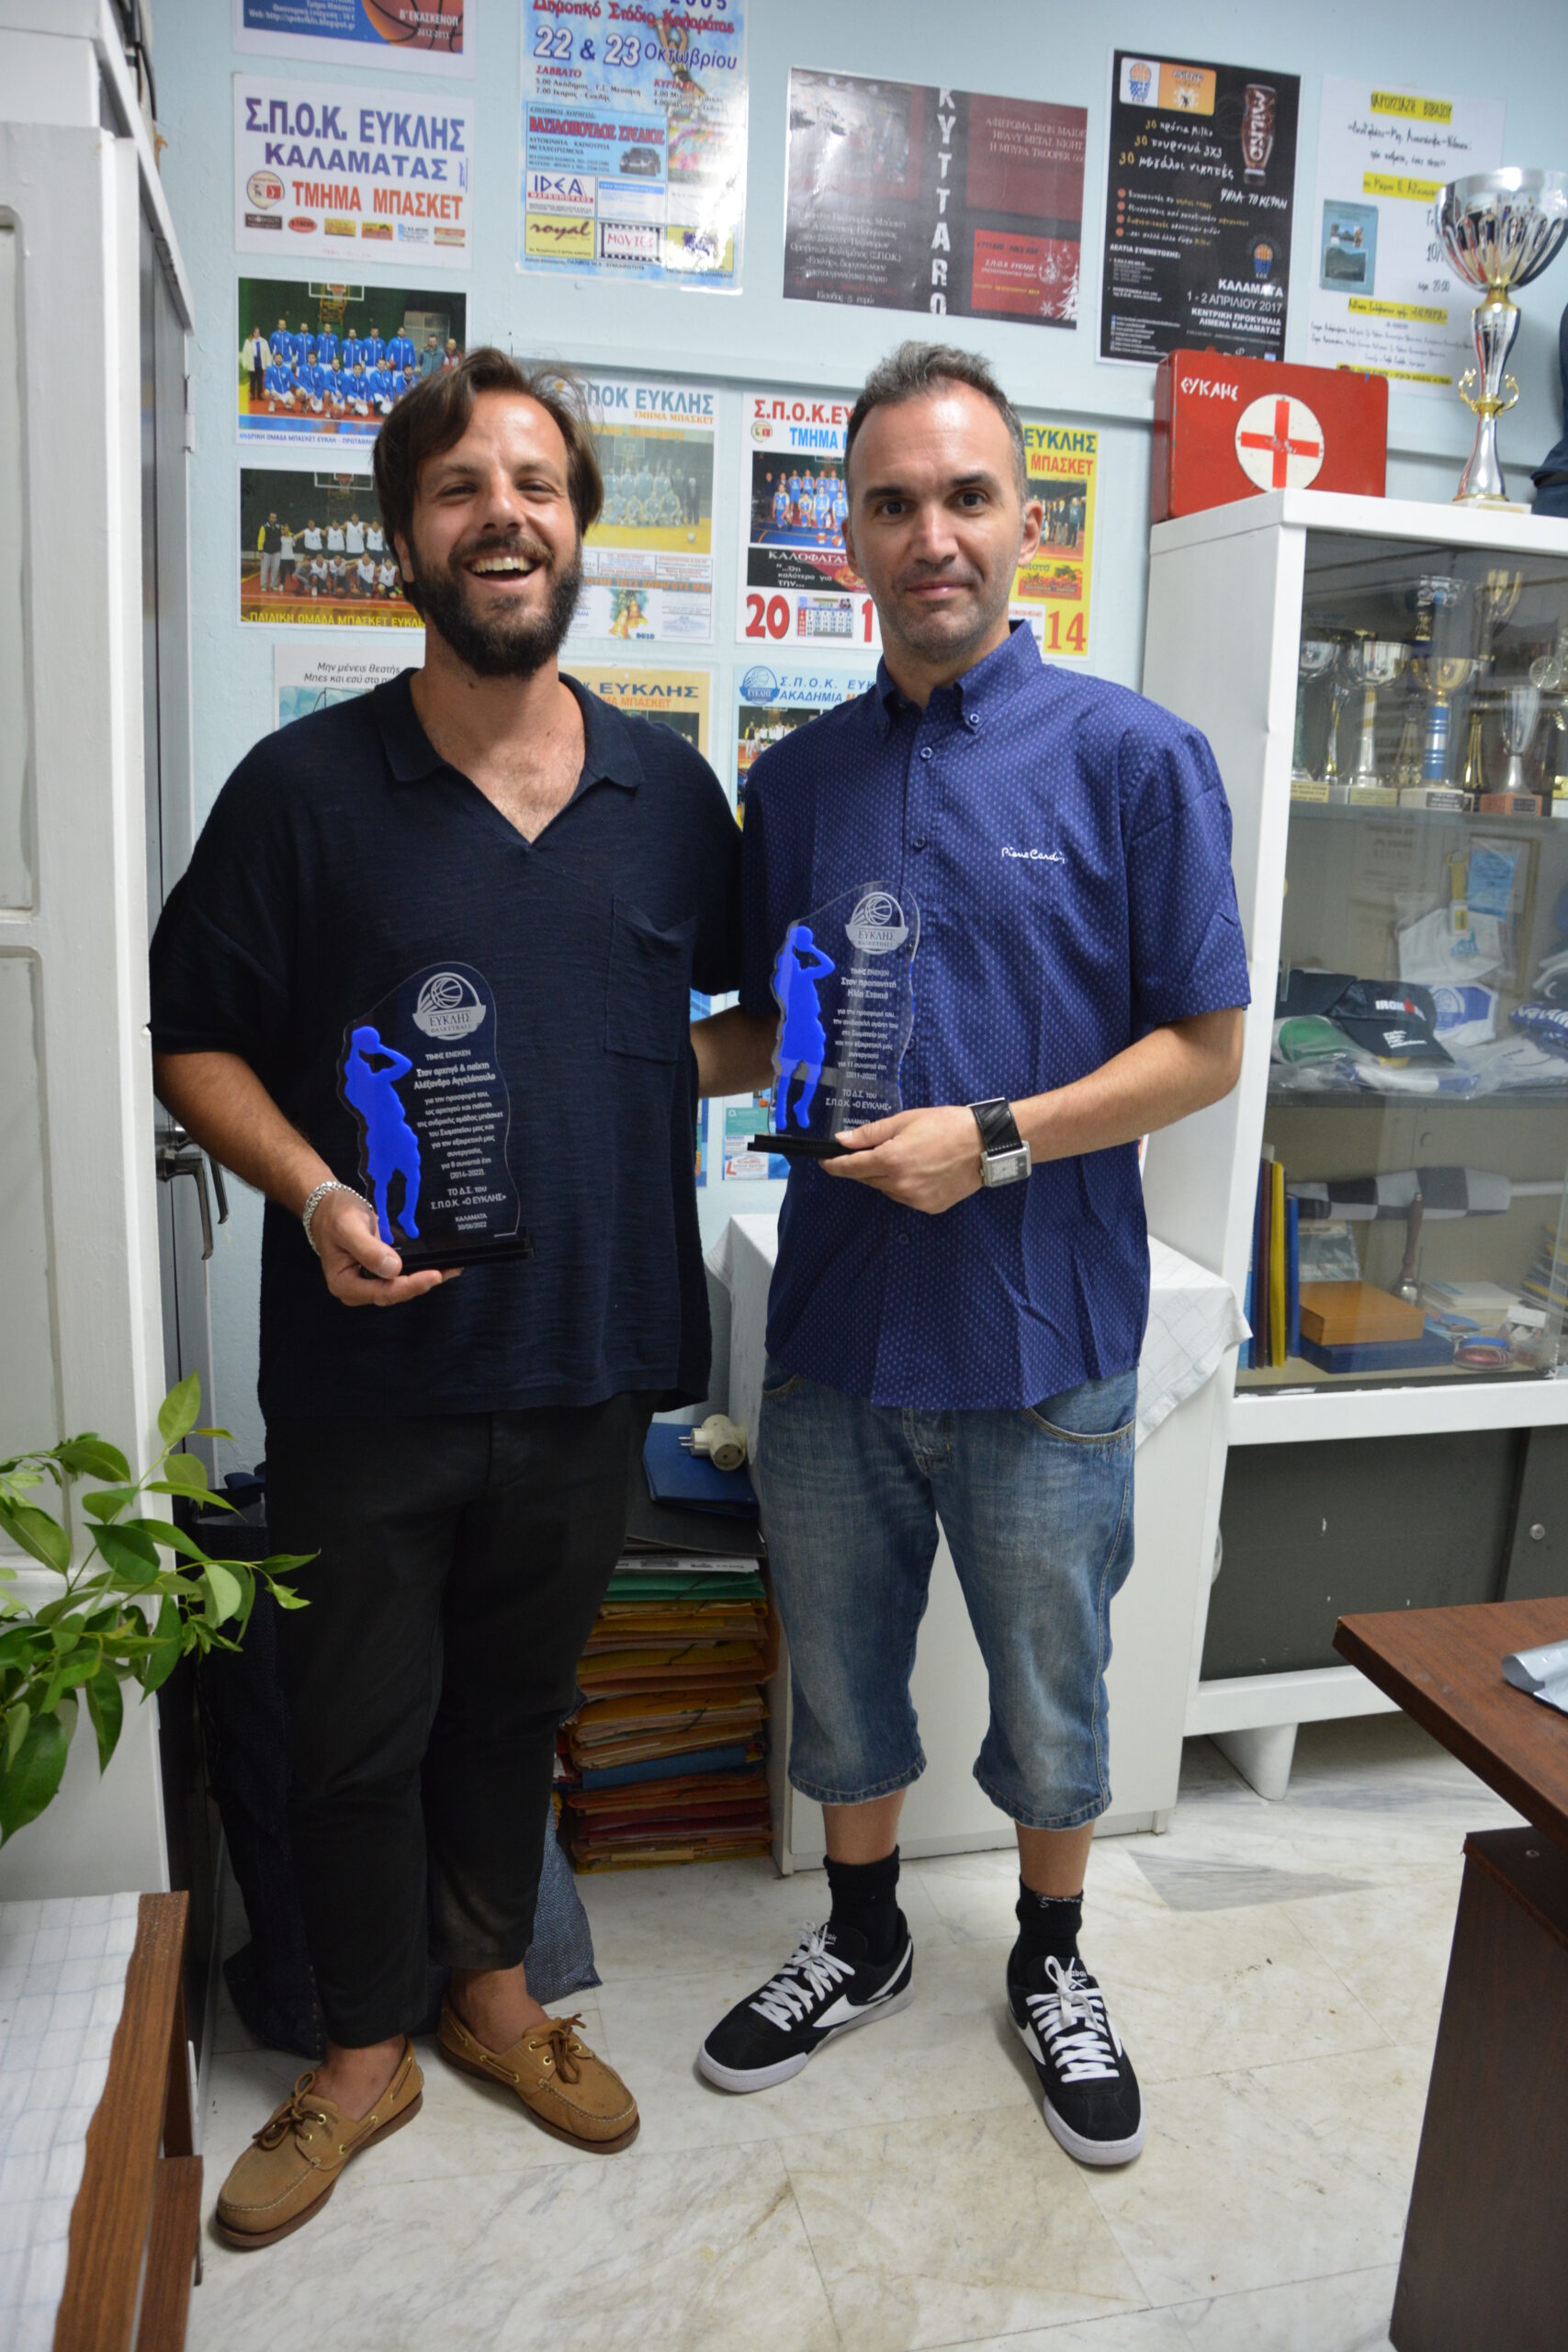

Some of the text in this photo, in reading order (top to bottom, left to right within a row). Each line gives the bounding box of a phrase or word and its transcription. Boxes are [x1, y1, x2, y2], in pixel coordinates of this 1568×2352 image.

[534, 25, 738, 71] 22 & 23 Οκτωβρίου
[536, 65, 582, 78] ΣΑΒΒΑΤΟ
[245, 96, 466, 153] Σ.Π.Ο.Κ. ΕΥΚΛΗΣ
[529, 116, 665, 145] ΒΑΣΙΛΟΠΟΥΛΟΣ ΣΤΕΛΙΟΣ
[1134, 135, 1201, 153] 30 τουρνουά
[265, 141, 448, 182] ΚΑΛΑΜΑΤΑΣ
[1119, 151, 1135, 166] 30
[1139, 156, 1185, 172] μεγάλοι
[291, 180, 463, 220] ΤΜΗΜΑ ΜΠΑΣΚΕΤ
[530, 220, 591, 242] royal
[606, 232, 653, 250] MOVIES
[1218, 278, 1284, 298] ΚΑΛΑΜΑΤΑ
[1208, 293, 1258, 311] ΑΠΡΙΛΙΟΥ
[1258, 300, 1282, 313] 2017
[1191, 307, 1282, 326] ΚΕΝΤΡΙΚΗ ΠΡΟΚΥΜΑΙΑ
[1199, 317, 1281, 336] ΛΙΜΕΝΑ ΚΑΛΑΜΑΤΑΣ
[636, 388, 715, 416] ΕΥΚΛΗΣ
[633, 411, 714, 425] ΤΜΗΜΑ ΜΠΑΣΚΕΤ
[266, 434, 287, 442] ΟΜΑΔΑ
[288, 435, 315, 443] ΜΠΑΣΚΕΤ
[789, 426, 838, 449] ΤΜΗΜΑ
[1024, 427, 1097, 454] ΕΥΚΛΗΣ
[1031, 454, 1093, 476] ΜΠΑΣΚΕΤ
[250, 611, 389, 627] ΠΑΙΔΙΚΗ ΟΜΑΔΑ ΜΠΑΣΚΕΤ
[745, 593, 790, 640] 20
[1047, 610, 1087, 651] 14
[317, 662, 336, 673] Μην
[304, 673, 379, 685] Μπες και εσύ στο
[780, 676, 838, 690] Σ.Π.Ο.Κ.
[600, 683, 699, 698] ΕΥΚΛΗΣ
[779, 690, 842, 703] ΑΚΑΔΗΜΙΑ
[621, 696, 671, 708] ΜΠΑΣΚΕΤ
[858, 931, 896, 942] ΕΥΚΛΗΣ
[841, 977, 857, 986] Στον
[428, 1012, 472, 1028] ΕΥΚΛΗΣ
[430, 1023, 472, 1035] BASKETBALL
[416, 1068, 433, 1078] Στον
[434, 1065, 458, 1077] αρχηγό
[413, 1078, 450, 1091] Αλέξανδρο
[842, 1089, 852, 1097] ΤΟ
[865, 1091, 877, 1100] του
[447, 1188, 458, 1196] ΤΟ
[455, 1213, 488, 1223] ΚΑΛΑΜΑΤΑ
